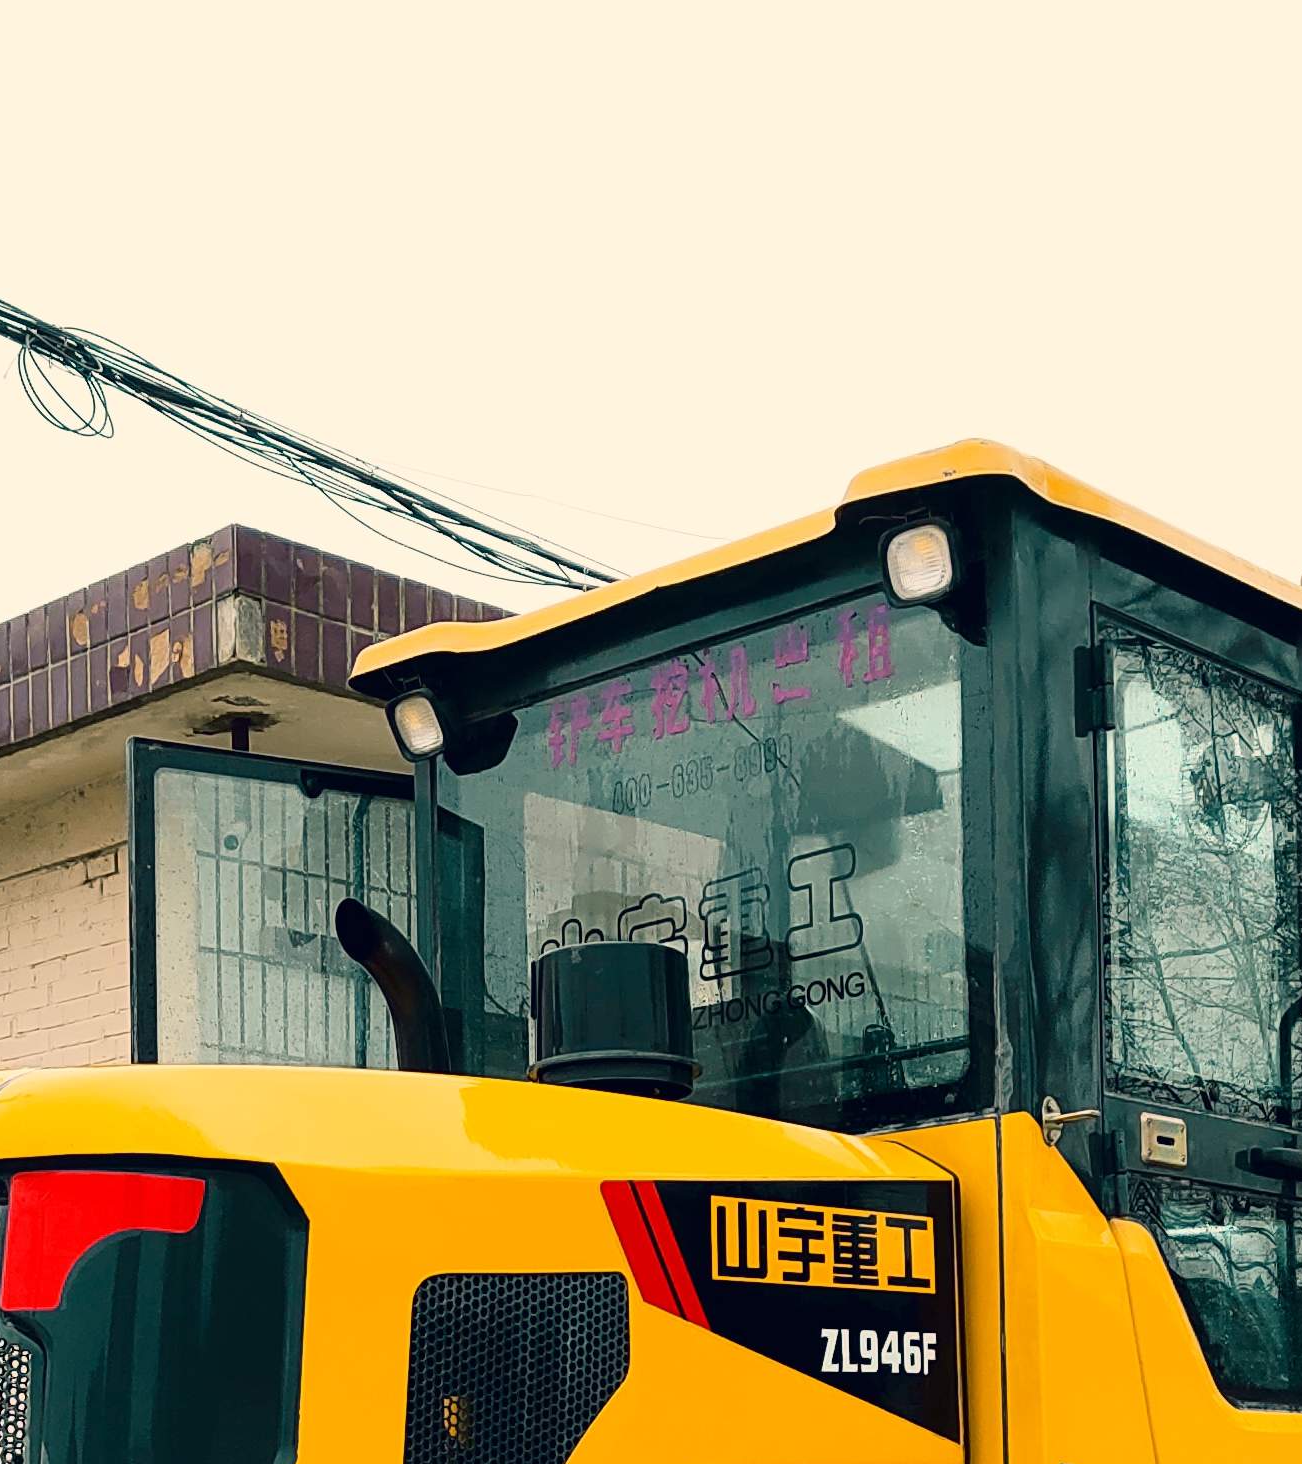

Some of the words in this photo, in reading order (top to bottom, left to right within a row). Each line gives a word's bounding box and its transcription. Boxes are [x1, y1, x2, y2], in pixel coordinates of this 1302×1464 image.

[693, 990, 783, 1031] ZHONG
[788, 971, 866, 1007] GONG
[715, 1200, 932, 1289] 山宇重工
[820, 1328, 937, 1375] ZL946F
